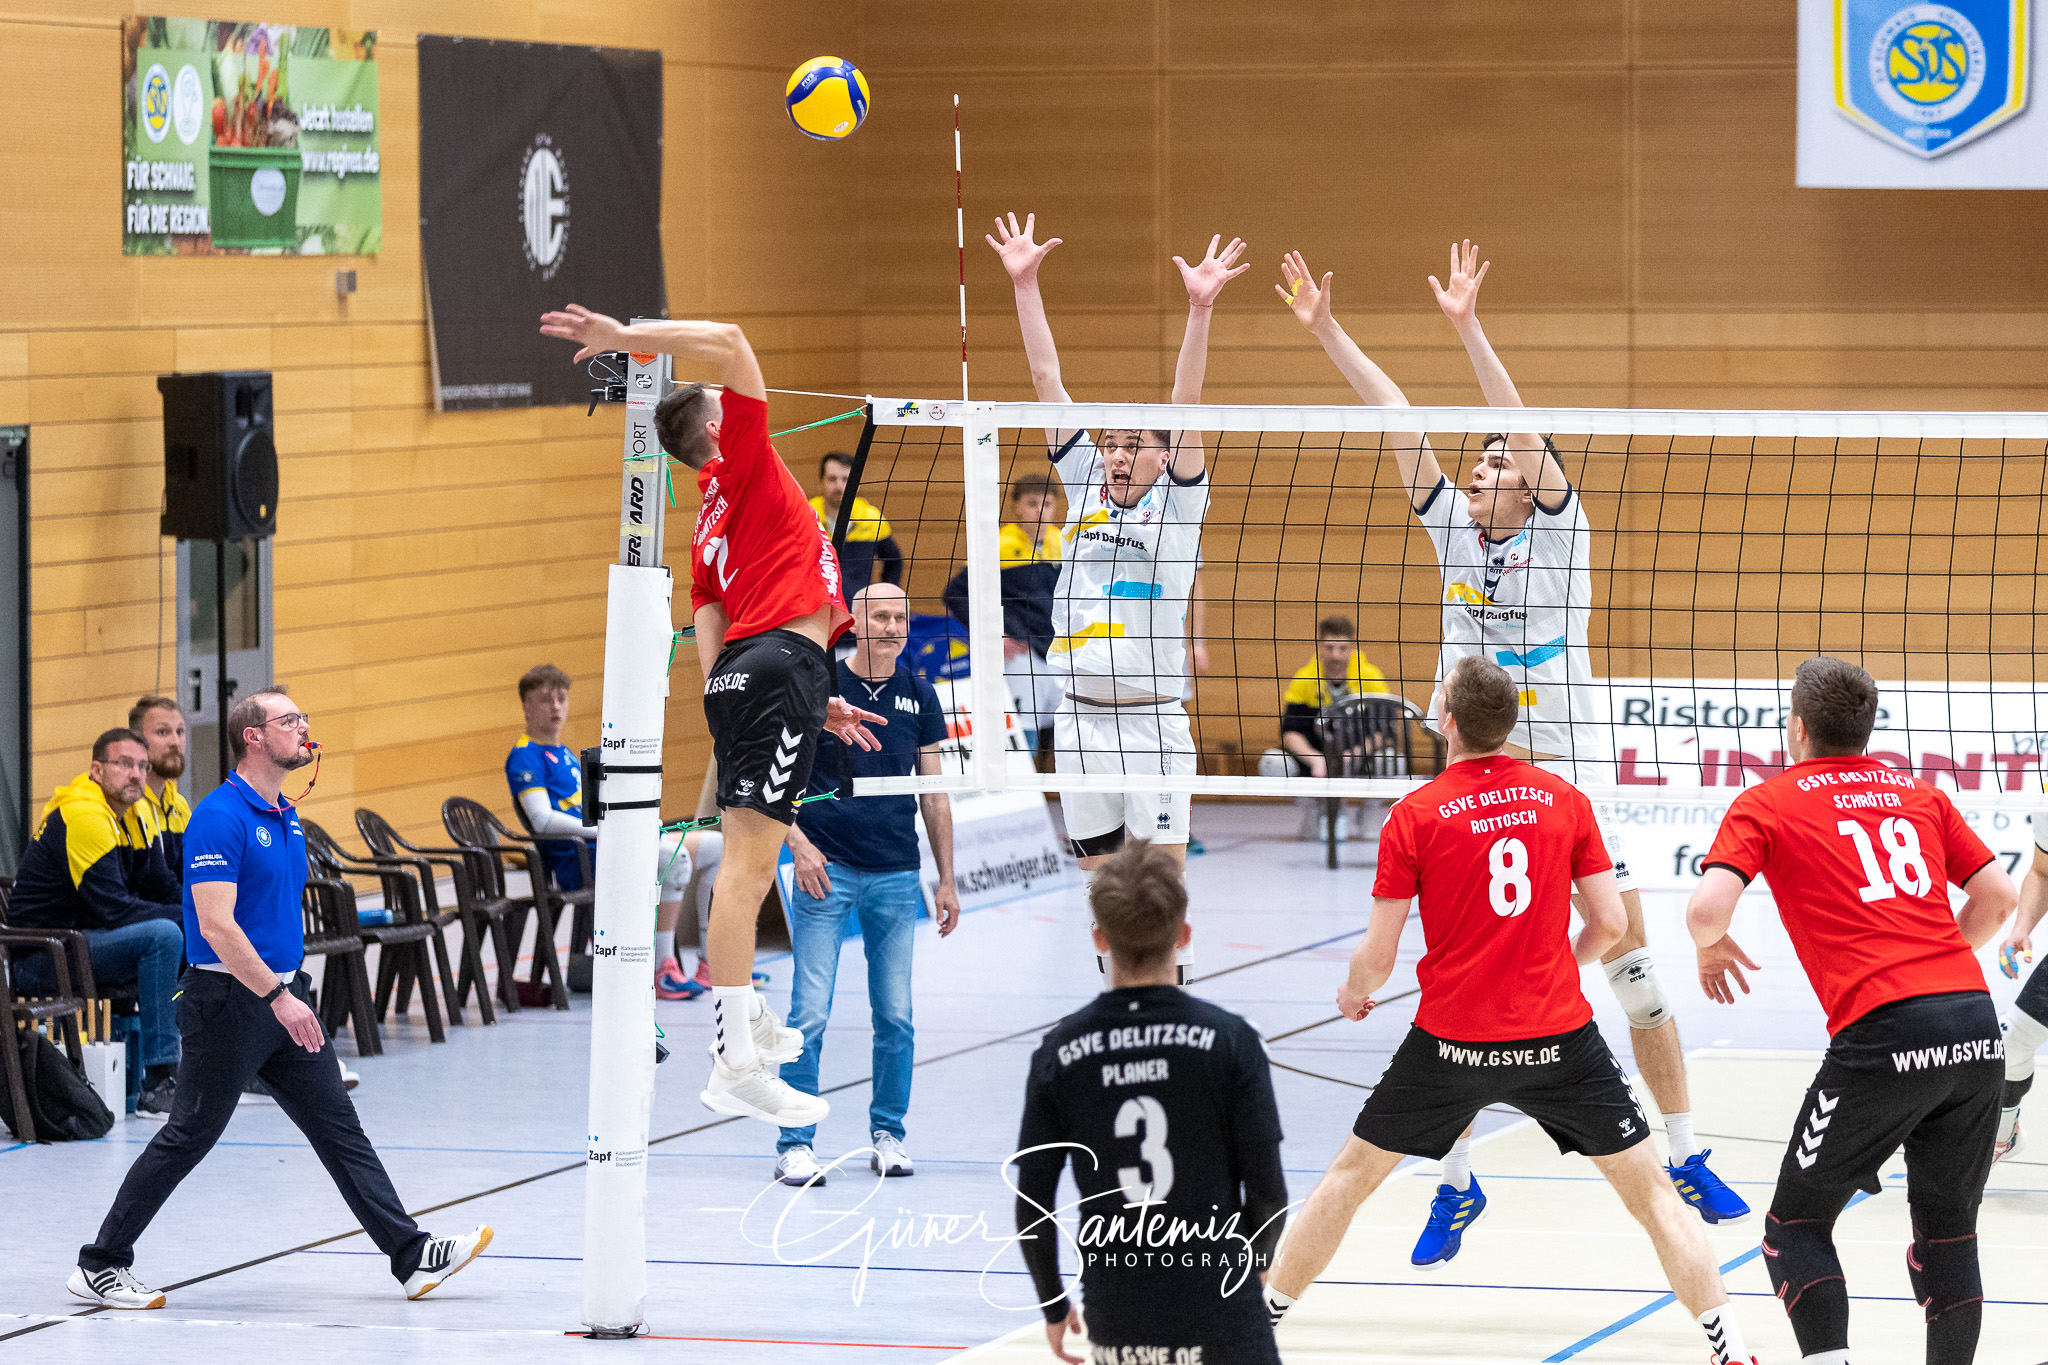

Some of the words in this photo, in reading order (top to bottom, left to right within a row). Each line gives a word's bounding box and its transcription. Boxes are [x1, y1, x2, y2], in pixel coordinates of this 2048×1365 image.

[127, 155, 150, 190] FÜR
[127, 198, 150, 234] FÜR
[633, 422, 647, 462] PORT
[628, 476, 645, 567] ERARD
[1081, 530, 1100, 541] apf
[1102, 532, 1148, 552] Daigfus
[703, 534, 739, 592] 2
[603, 738, 626, 750] Zapf
[1796, 773, 1838, 791] GSVE
[1838, 770, 1915, 790] DELITZSCH
[1438, 795, 1477, 819] GSVE
[1479, 786, 1554, 807] DELITZSCH
[1832, 791, 1902, 809] SCHRÖTER
[1470, 810, 1538, 834] ROTTOSCH
[1837, 816, 1932, 903] 18
[1488, 837, 1532, 918] 8
[595, 945, 617, 957] Zapf
[1057, 1031, 1105, 1066] GSVE
[1109, 1023, 1216, 1051] DELITZSCH
[1438, 1040, 1561, 1067] WWW.GSVE.DE
[1891, 1038, 2004, 1073] WWW.GSVE.DE
[1102, 1058, 1170, 1087] PLANER
[589, 1150, 612, 1163] Zapf
[1114, 1095, 1175, 1204] 3
